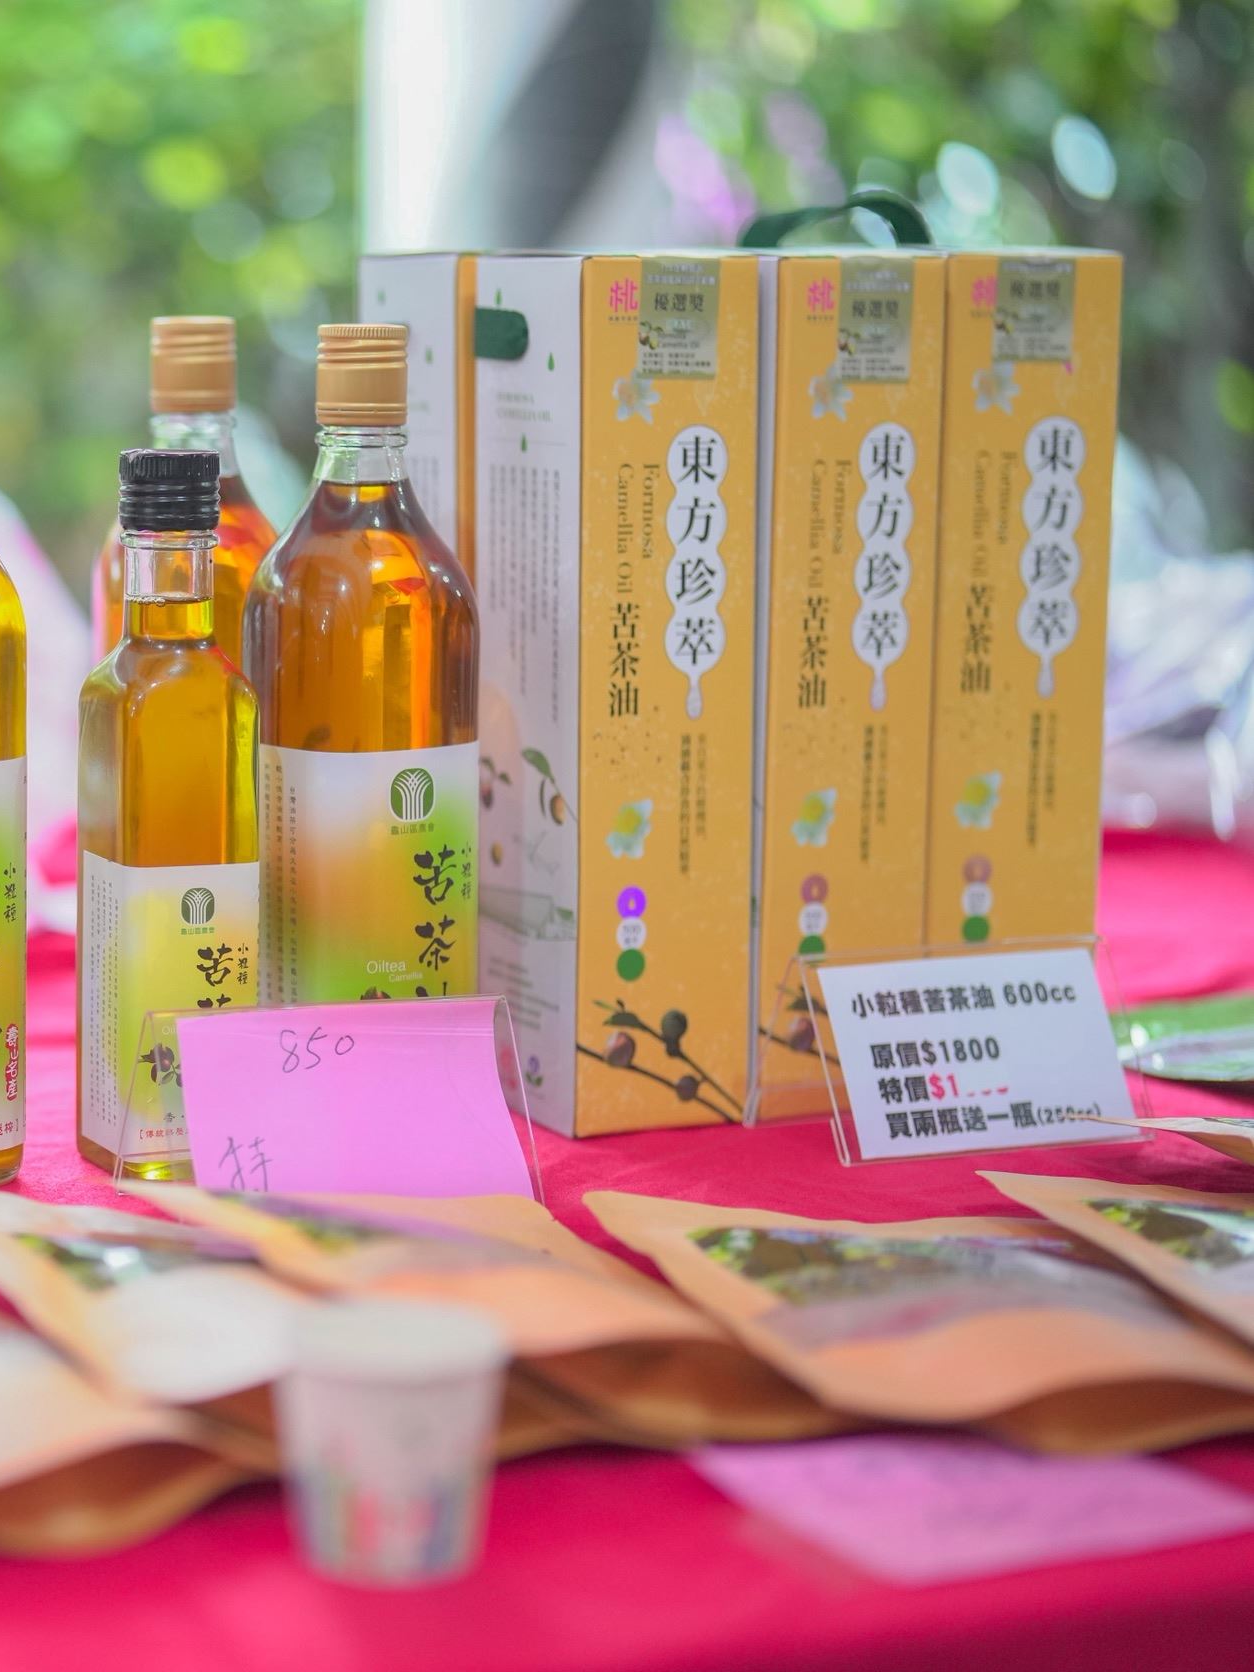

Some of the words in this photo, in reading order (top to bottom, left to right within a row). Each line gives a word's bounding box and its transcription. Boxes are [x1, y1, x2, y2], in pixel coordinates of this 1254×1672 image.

[616, 462, 635, 556] Camellia
[642, 462, 660, 559] Formosa
[809, 458, 828, 548] Camellia
[833, 459, 852, 555] Formosa
[863, 432, 907, 659] 東方珍萃
[1029, 428, 1075, 647] 東方珍萃
[615, 560, 634, 595] Oil
[675, 435, 717, 667] 東方珍萃
[807, 555, 825, 589] Oil
[608, 602, 640, 717] 苦茶油
[797, 595, 830, 710] 苦茶油
[959, 585, 995, 694] 苦茶油
[237, 942, 250, 985] 小粒種
[412, 844, 457, 997] 苦茶
[196, 943, 234, 1009] 苦
[366, 959, 406, 975] Oiltea
[389, 972, 423, 983] Camellia
[851, 985, 996, 1019] 小粒種苦茶油
[1003, 982, 1077, 1006] 600cc
[279, 1026, 356, 1074] 850
[871, 1037, 1001, 1070] 原價$1800
